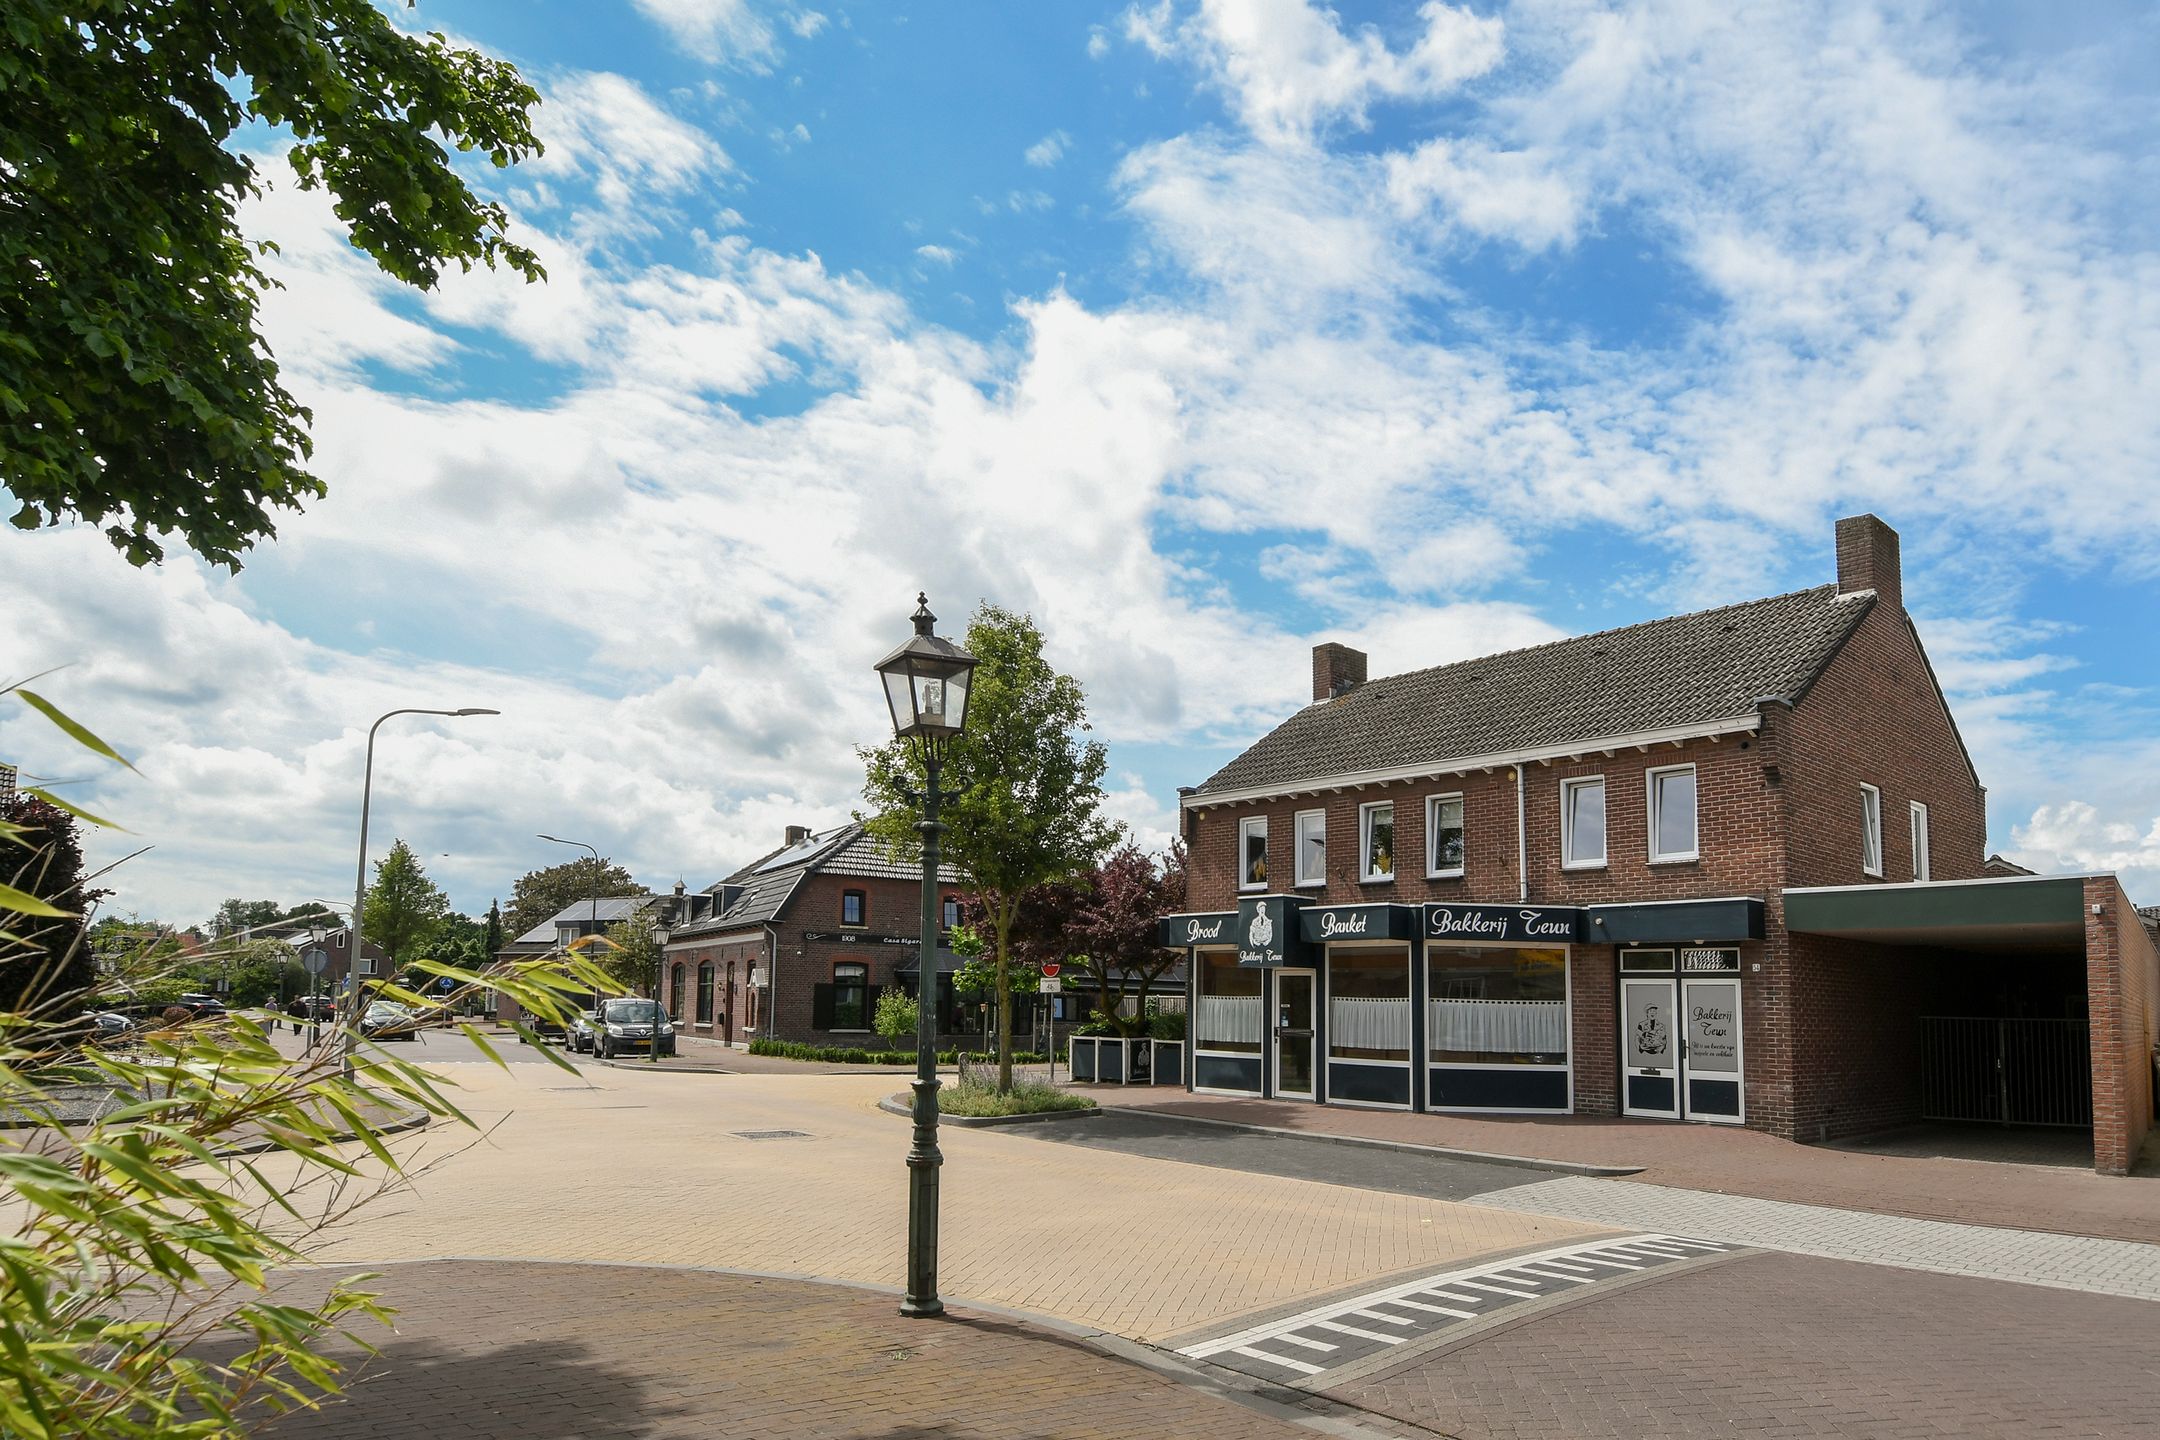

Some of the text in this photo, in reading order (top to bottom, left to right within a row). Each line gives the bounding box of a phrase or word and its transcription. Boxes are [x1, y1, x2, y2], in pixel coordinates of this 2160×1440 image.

[1186, 919, 1222, 942] Brood
[1320, 912, 1367, 938] Banket
[1431, 909, 1570, 939] Bakkerij Teun
[1240, 950, 1264, 964] Bakkerij
[1692, 1006, 1733, 1023] Bakkerij
[1700, 1021, 1727, 1036] Teun
